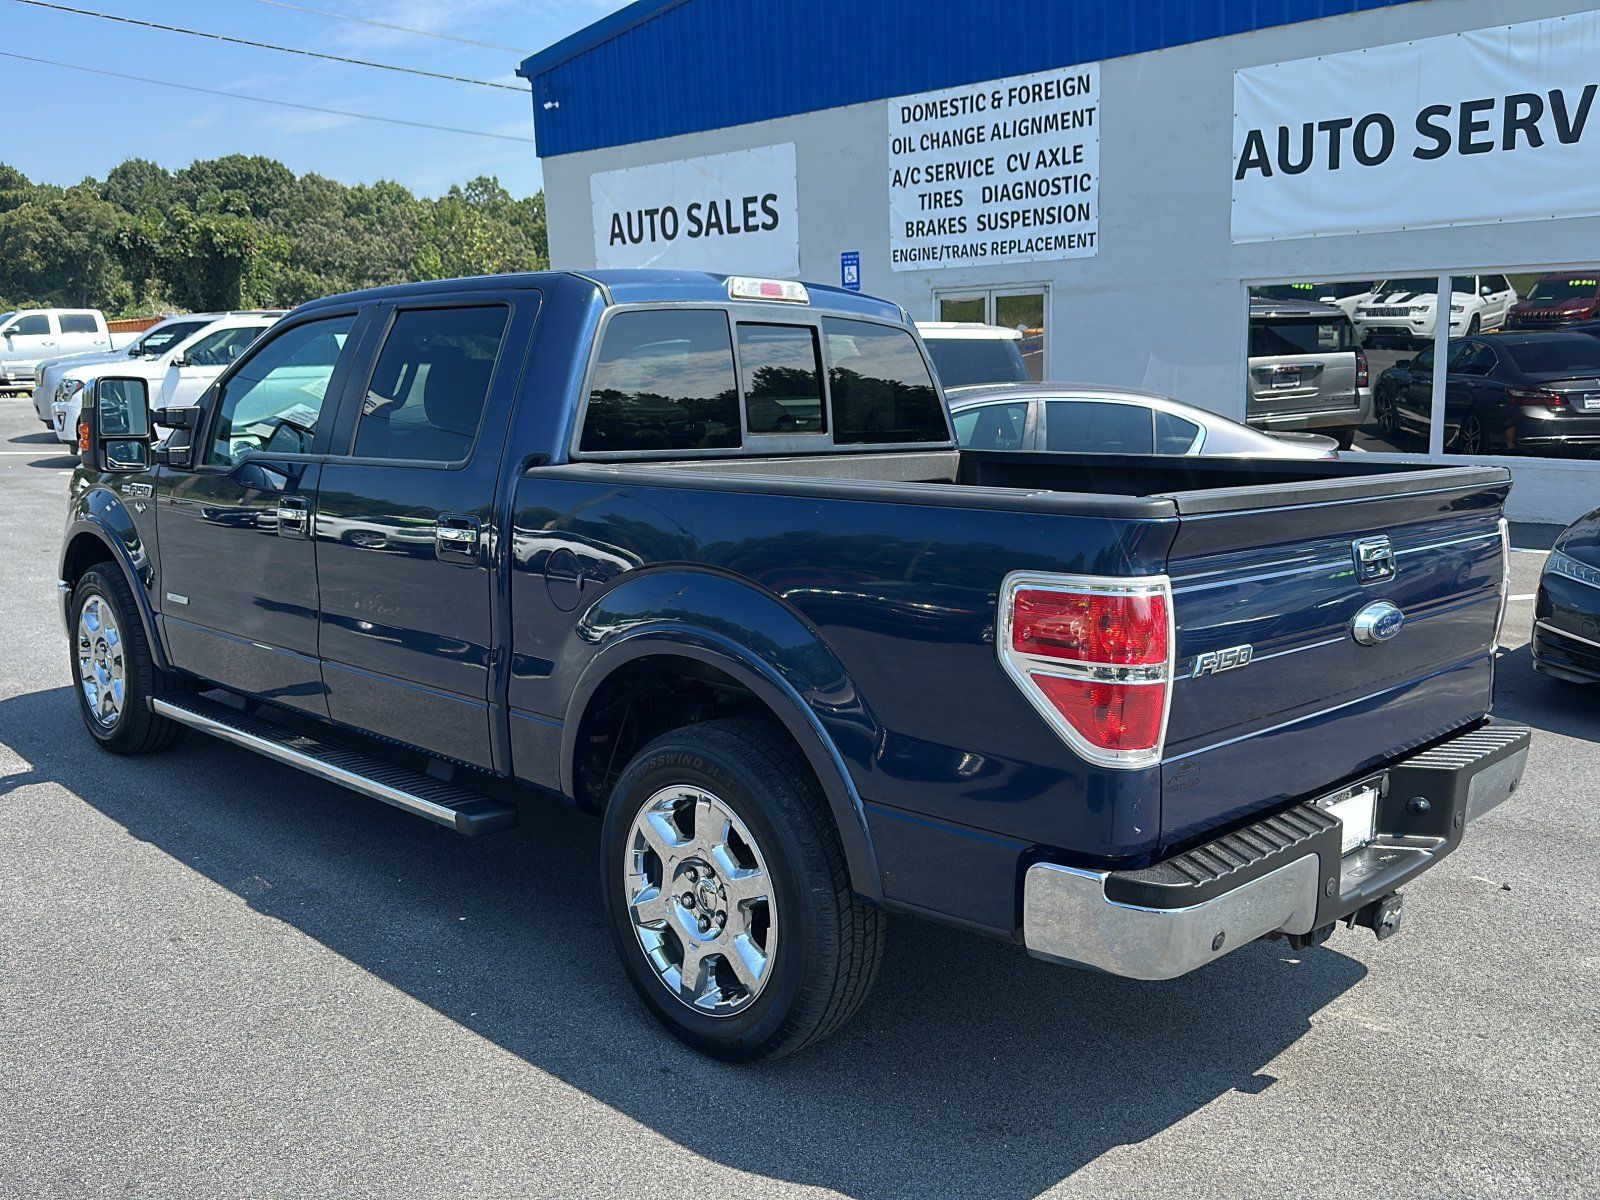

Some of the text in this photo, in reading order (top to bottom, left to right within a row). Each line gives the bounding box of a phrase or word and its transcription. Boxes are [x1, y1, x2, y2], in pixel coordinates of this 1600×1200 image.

[901, 74, 1091, 124] DOMESTIC & FOREIGN
[892, 107, 1096, 155] OIL CHANGE ALIGNMENT
[1235, 84, 1599, 180] AUTO SERV
[892, 145, 1084, 189] A/C SERVICE CV AXLE
[919, 173, 1091, 211] TIRES DIAGNOSTIC
[609, 193, 779, 246] AUTO SALES
[905, 202, 1091, 238] BRAKES SUSPENSION
[892, 232, 1097, 262] ENGINE/TRANS REPLACEMENT
